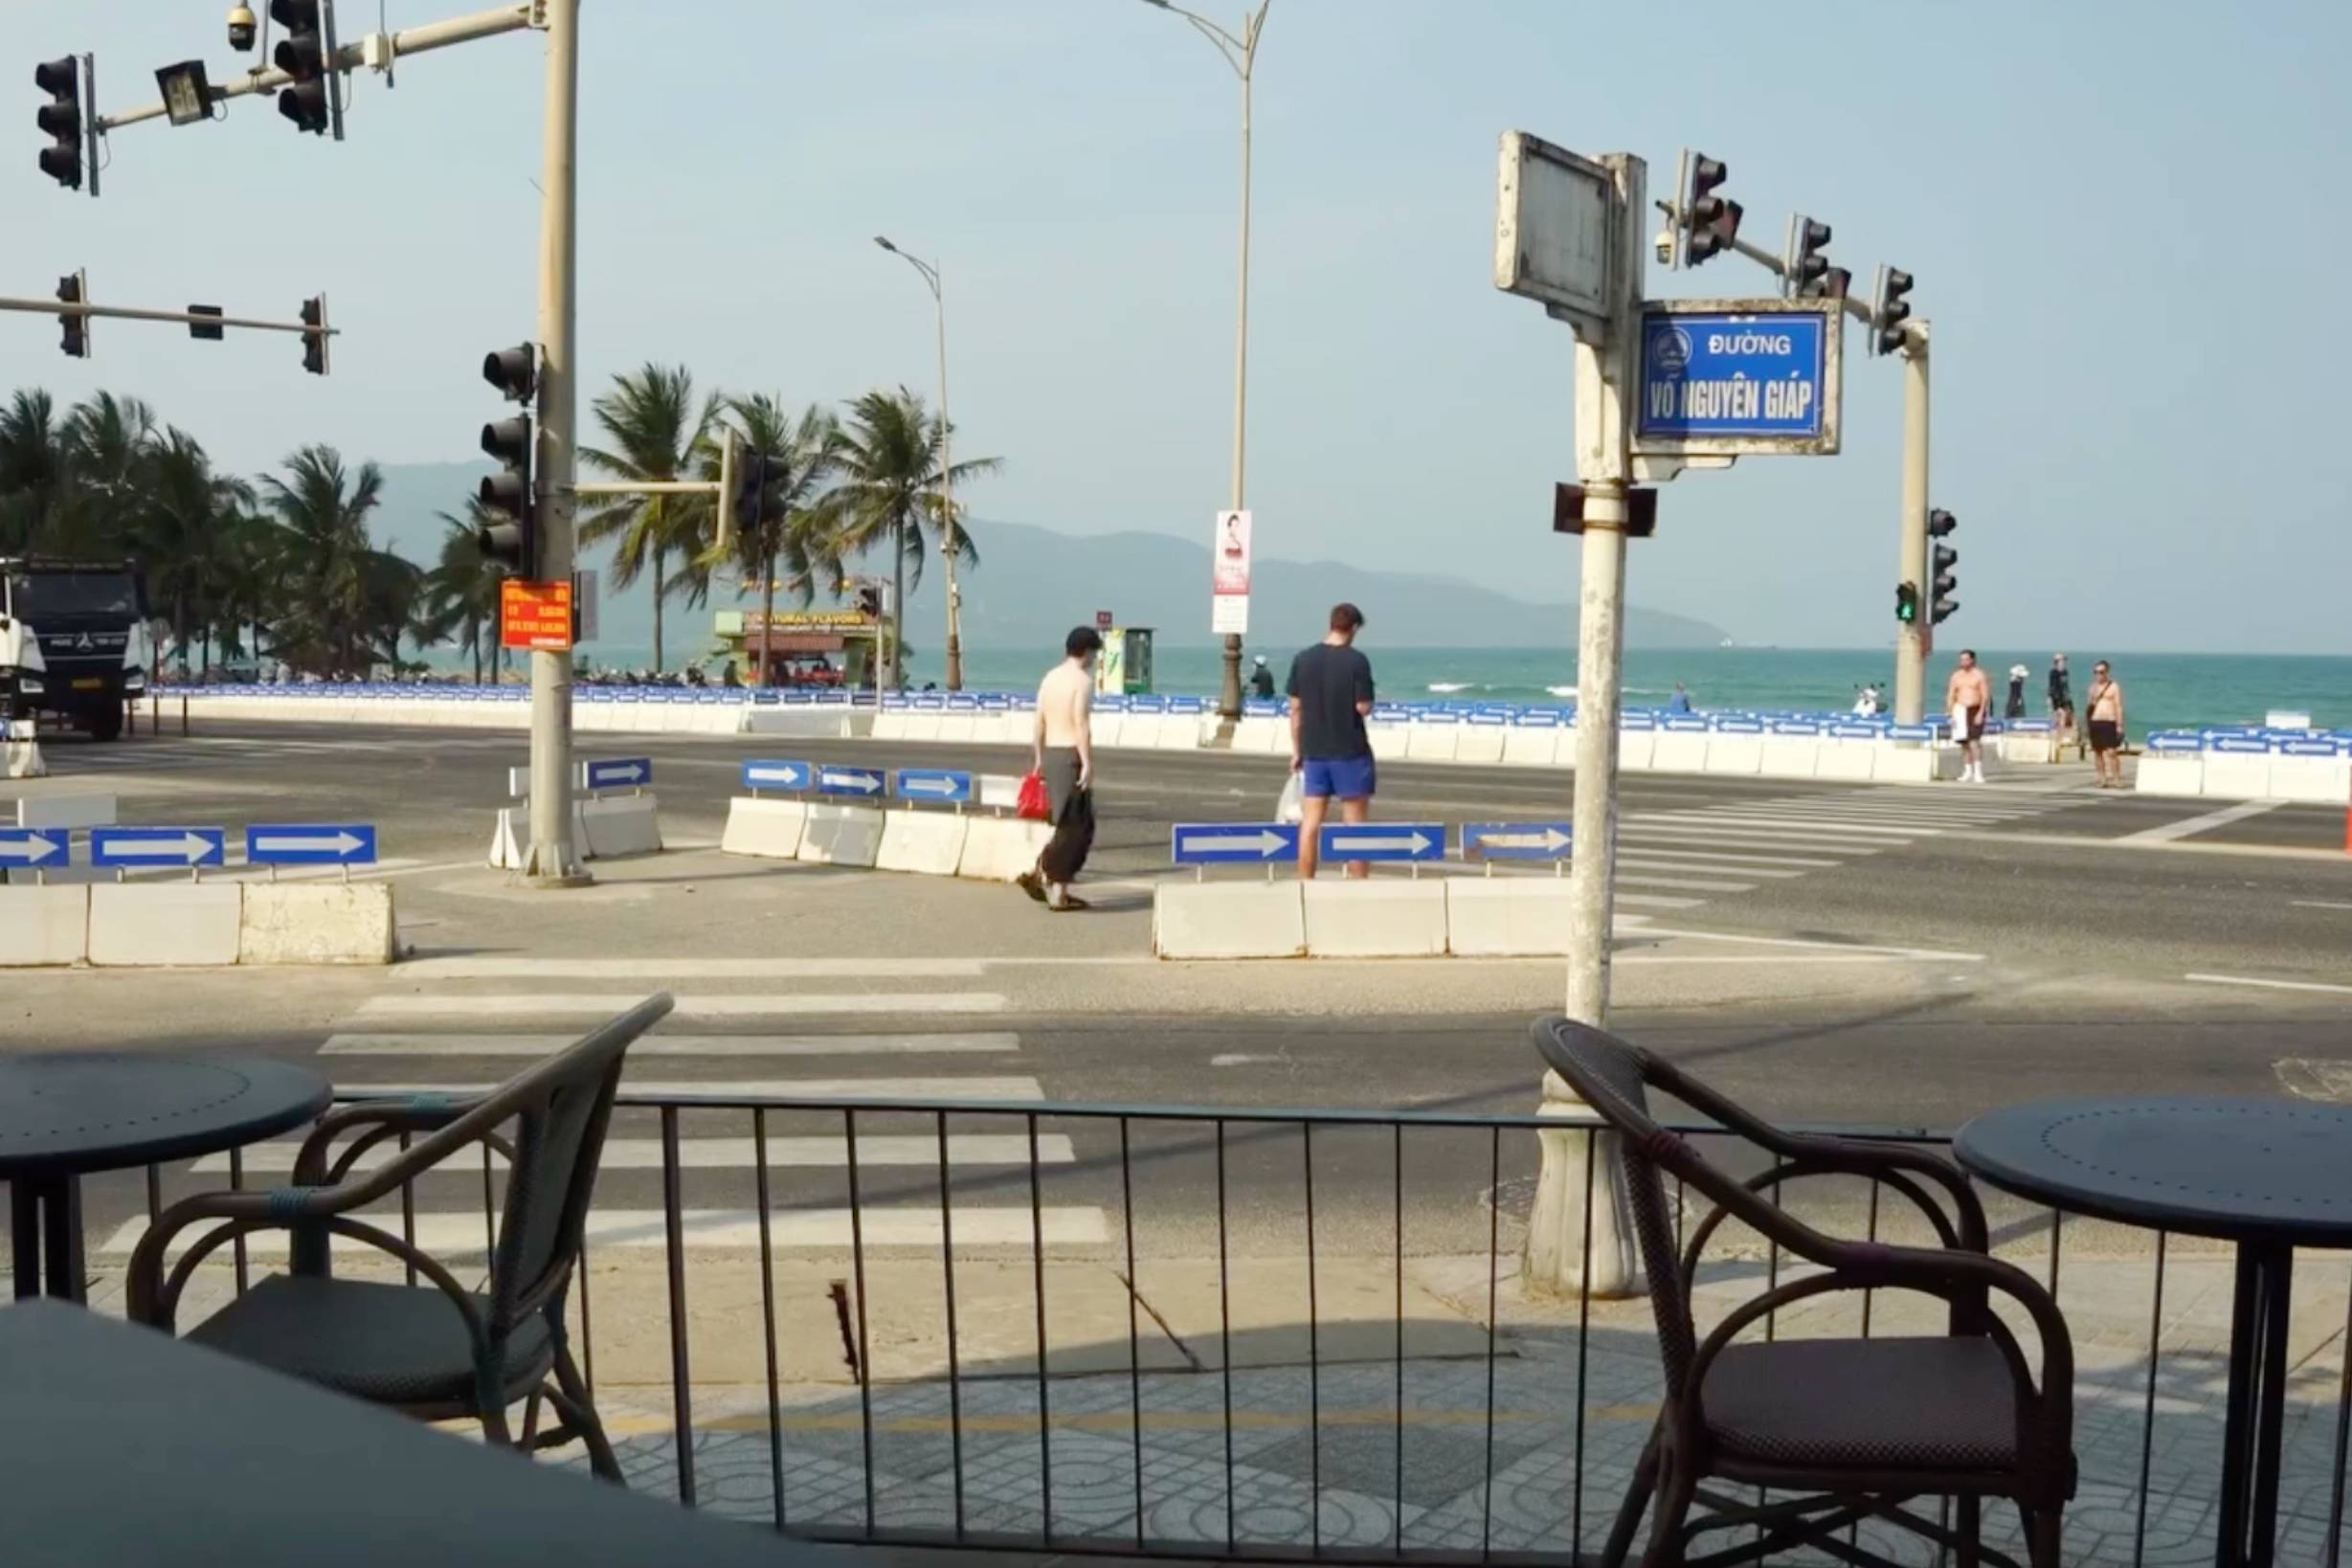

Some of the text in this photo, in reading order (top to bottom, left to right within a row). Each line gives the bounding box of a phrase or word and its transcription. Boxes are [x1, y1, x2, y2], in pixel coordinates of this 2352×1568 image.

[1708, 329, 1792, 354] ĐƯỜNG
[1681, 371, 1758, 419] NGUYÊN
[1764, 370, 1813, 419] GIÁP
